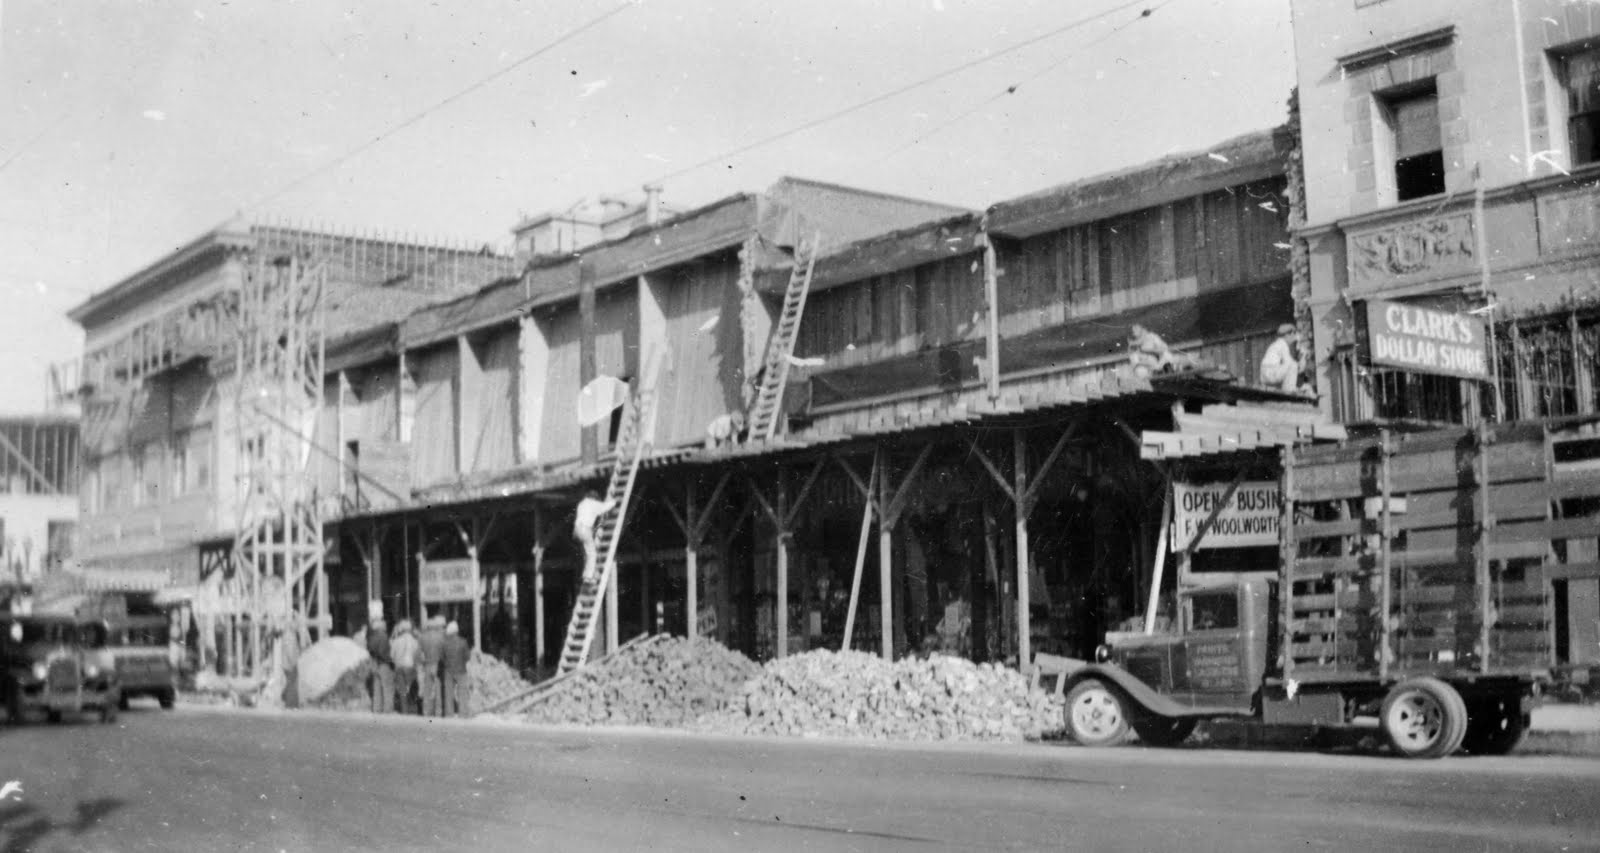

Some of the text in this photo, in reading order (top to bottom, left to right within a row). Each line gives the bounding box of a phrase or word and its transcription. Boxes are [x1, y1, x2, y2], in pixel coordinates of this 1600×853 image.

[1386, 304, 1473, 344] CLARK'S
[1376, 333, 1486, 376] DOLLAR STORE
[1182, 490, 1220, 512] OPEN
[1237, 490, 1279, 511] BUSIN
